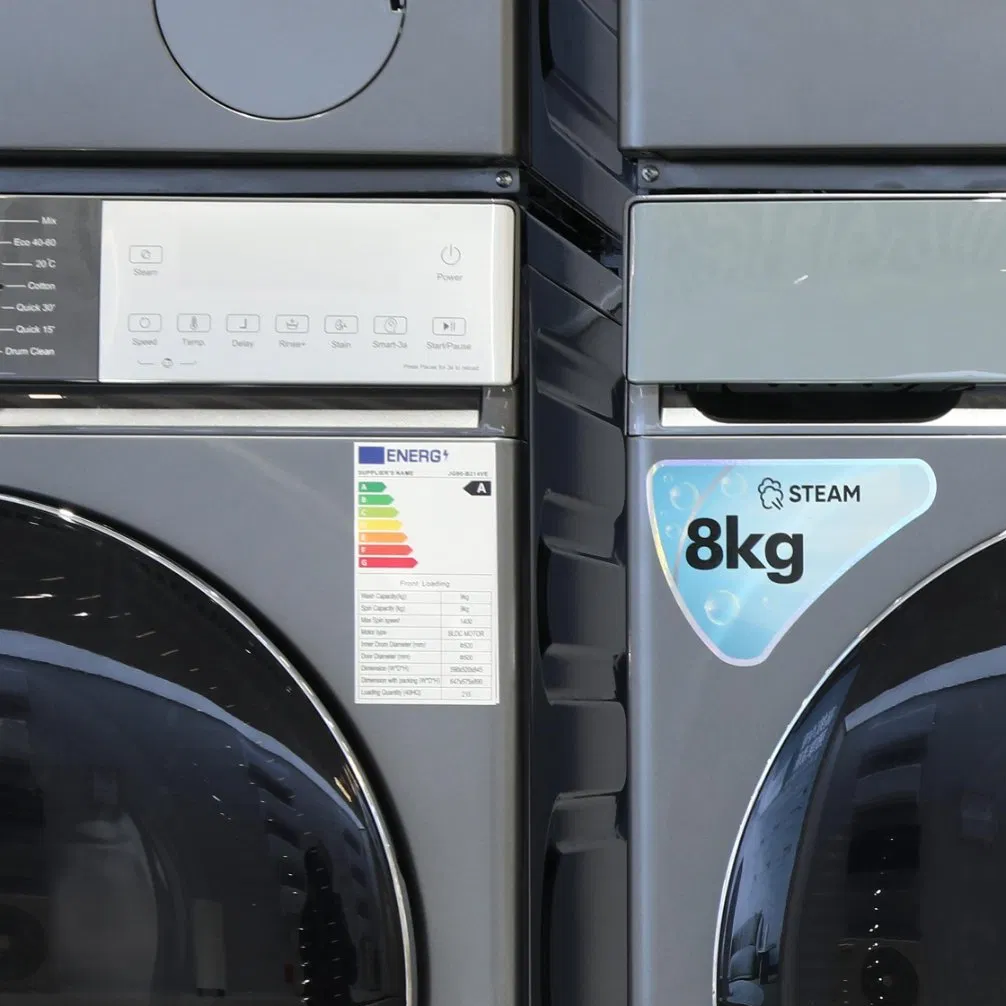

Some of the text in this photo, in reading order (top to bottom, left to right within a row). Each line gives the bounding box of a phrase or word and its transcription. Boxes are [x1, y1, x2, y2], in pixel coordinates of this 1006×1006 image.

[41, 216, 57, 225] Mix
[14, 238, 30, 246] Eco
[437, 272, 463, 282] Power
[28, 281, 56, 290] Cotton
[16, 303, 40, 312] Quick
[16, 325, 40, 334] Quick
[5, 347, 56, 356] Drum Clean
[386, 448, 441, 462] ENERG
[476, 482, 486, 494] A
[789, 485, 860, 502] STEAM
[685, 515, 804, 584] 8kg
